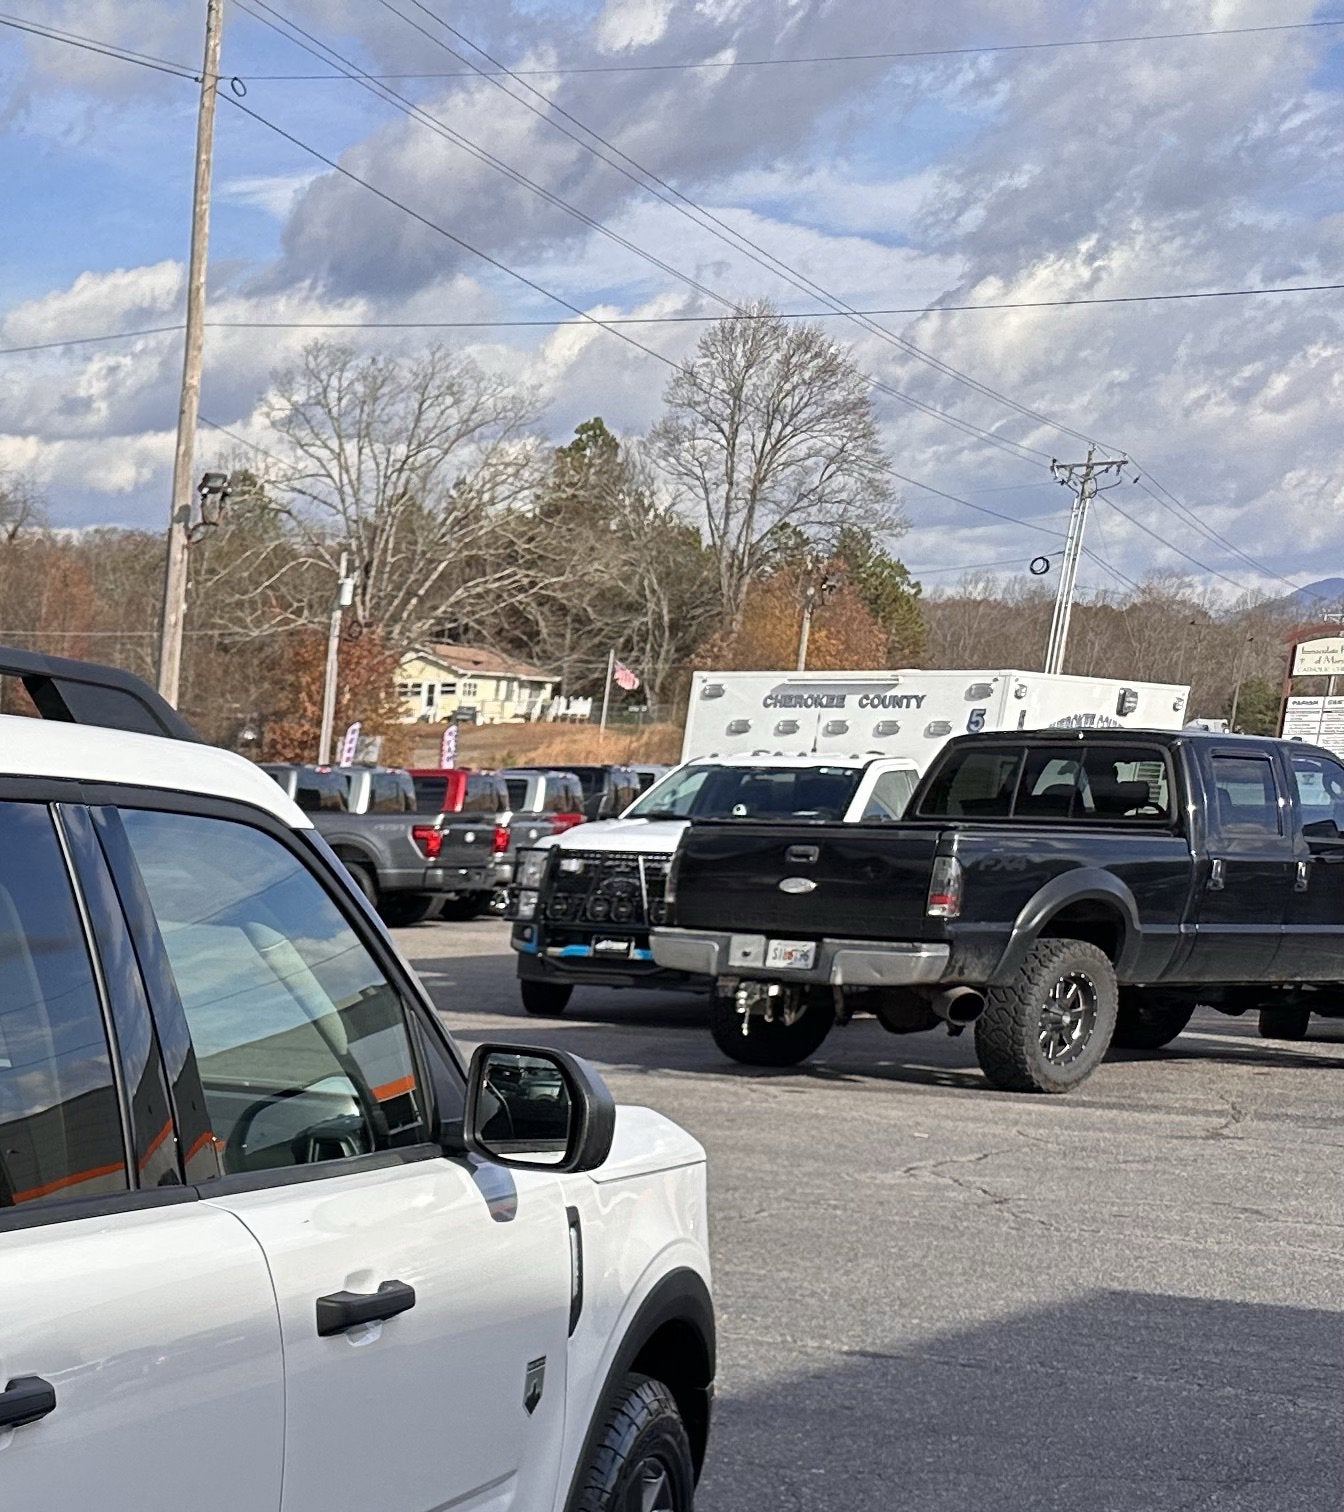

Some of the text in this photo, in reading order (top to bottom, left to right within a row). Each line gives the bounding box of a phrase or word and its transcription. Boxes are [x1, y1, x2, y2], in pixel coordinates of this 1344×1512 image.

[762, 694, 927, 709] CHEROKEE COUNTY
[967, 709, 987, 733] 5
